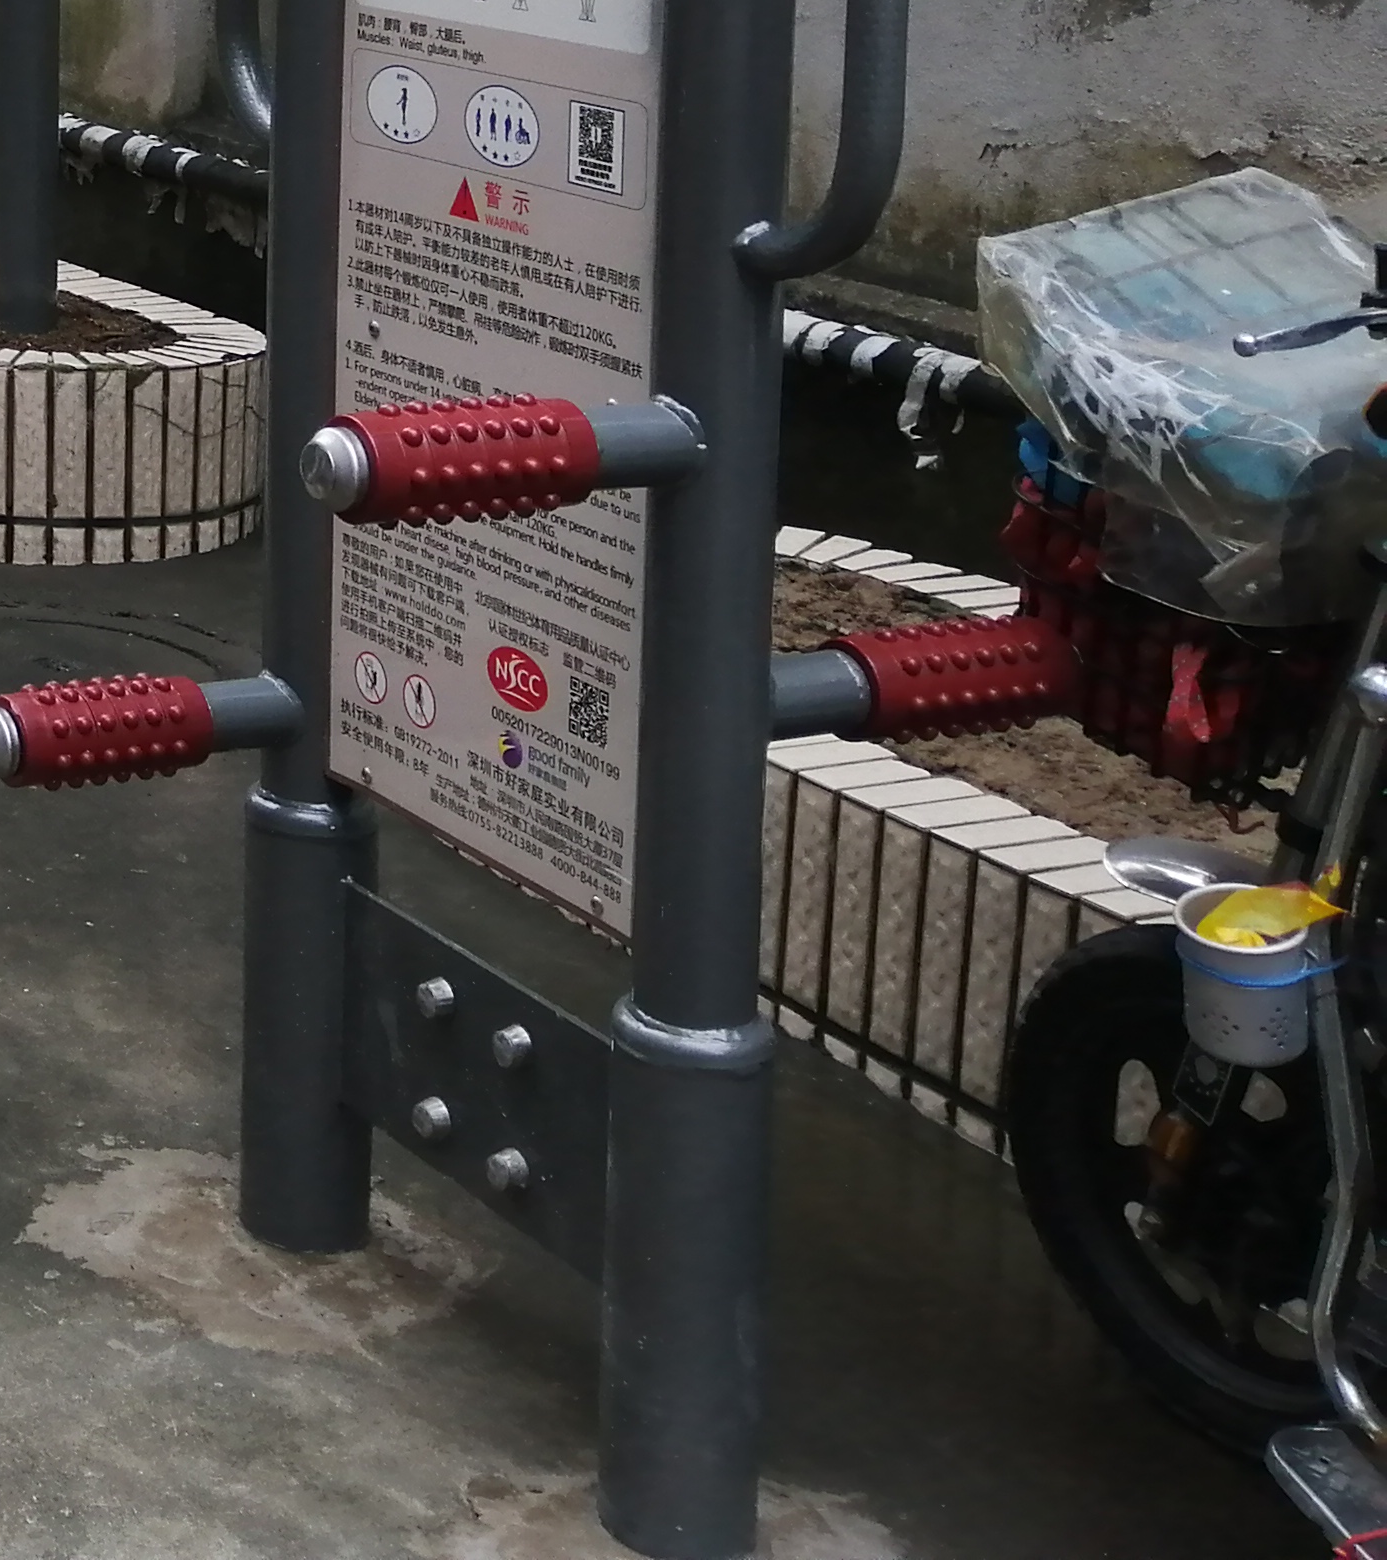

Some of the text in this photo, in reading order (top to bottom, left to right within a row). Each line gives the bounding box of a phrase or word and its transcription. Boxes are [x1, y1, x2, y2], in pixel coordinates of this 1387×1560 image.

[398, 36, 425, 55] Waist,
[461, 47, 486, 66] thigh.
[484, 179, 531, 219] 警示
[484, 212, 529, 237] WARNING
[354, 359, 441, 401] For persons under 14
[590, 493, 610, 514] due
[609, 500, 621, 518] to
[381, 530, 392, 545] be
[394, 535, 418, 555] under
[419, 546, 435, 563] the
[433, 523, 467, 549] machine
[468, 537, 488, 558] after
[488, 545, 522, 574] drinking
[522, 559, 533, 576] or
[533, 563, 553, 584] with
[549, 511, 636, 555] one person and the
[399, 523, 422, 544] heart
[454, 545, 475, 568] high
[476, 554, 501, 577] blood
[543, 582, 562, 602] and
[563, 590, 588, 613] other
[590, 601, 632, 631] diseases
[537, 536, 558, 558] Hold
[558, 544, 575, 564] the
[575, 550, 608, 578] handles
[609, 563, 634, 590] firmly
[493, 644, 542, 705] NSCC
[557, 755, 591, 790] family
